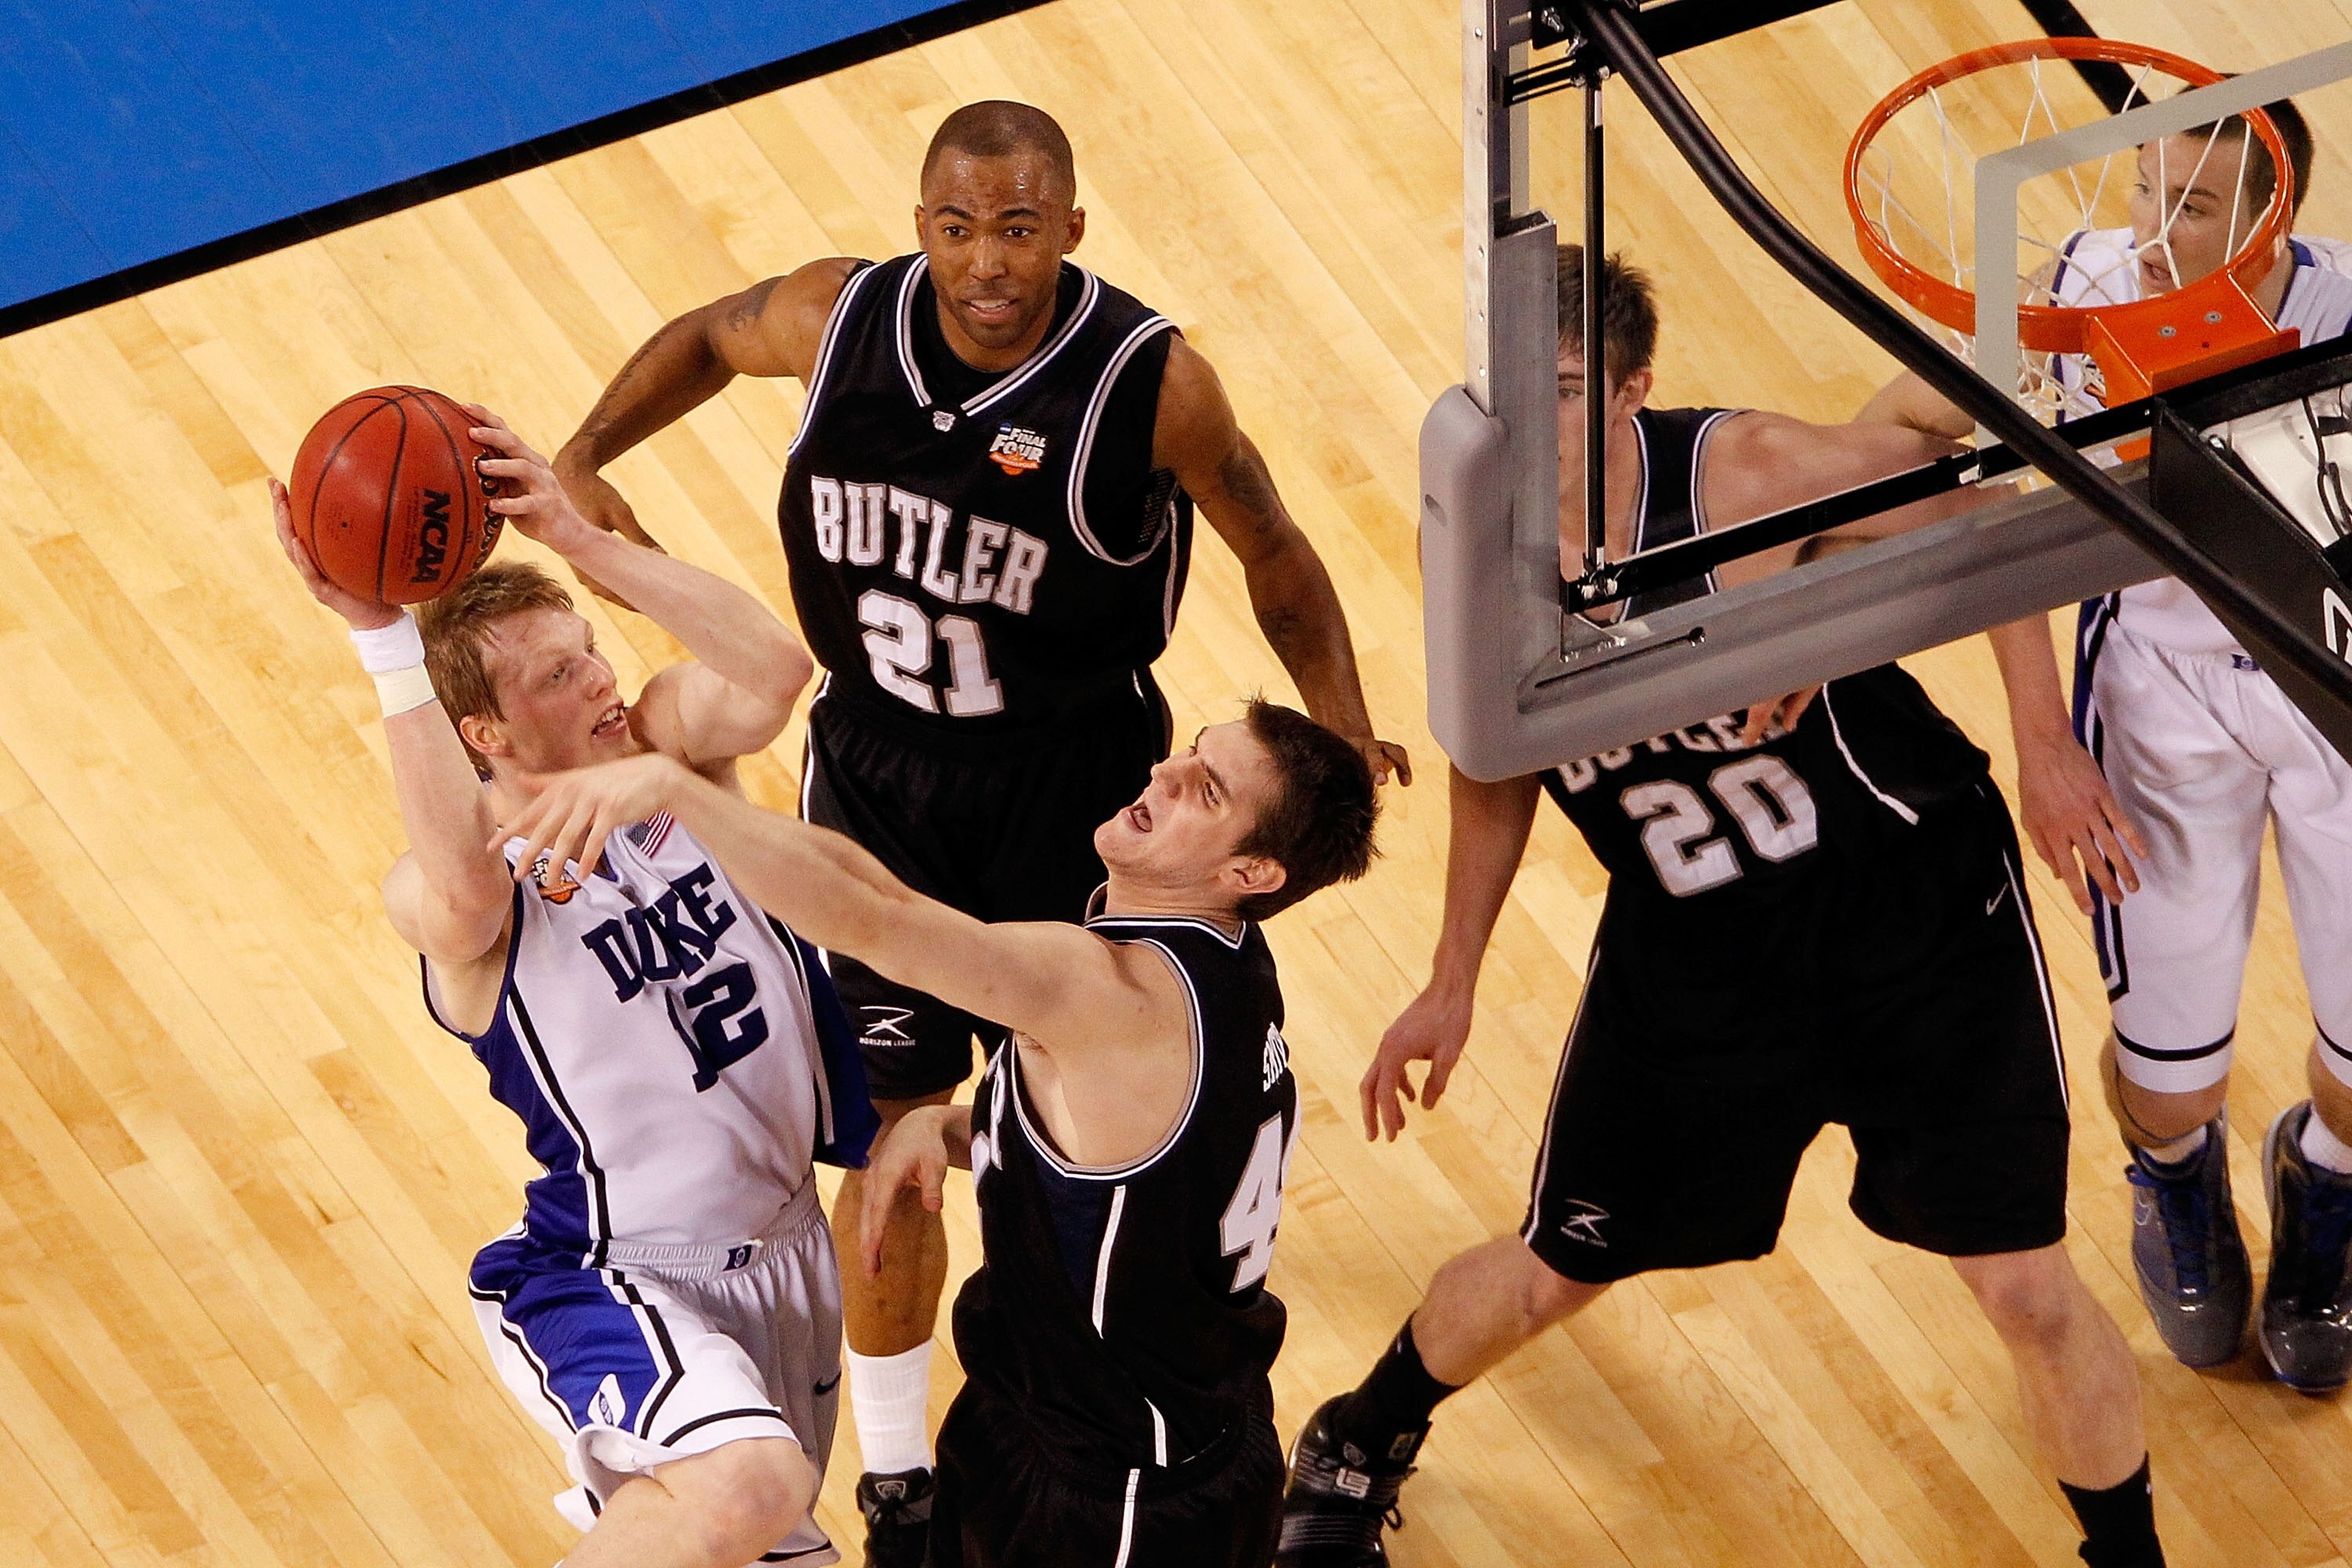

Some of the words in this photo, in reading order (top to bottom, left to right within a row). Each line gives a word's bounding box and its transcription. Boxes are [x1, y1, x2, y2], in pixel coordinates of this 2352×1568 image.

[989, 433, 1044, 463] FOUR
[1007, 427, 1047, 448] FINAL
[410, 488, 452, 583] NCAA
[811, 474, 1049, 615] BUTLER
[857, 588, 1004, 717] 21
[1618, 753, 1818, 898] 20
[581, 861, 737, 1004] DUKE
[664, 962, 769, 1094] 12
